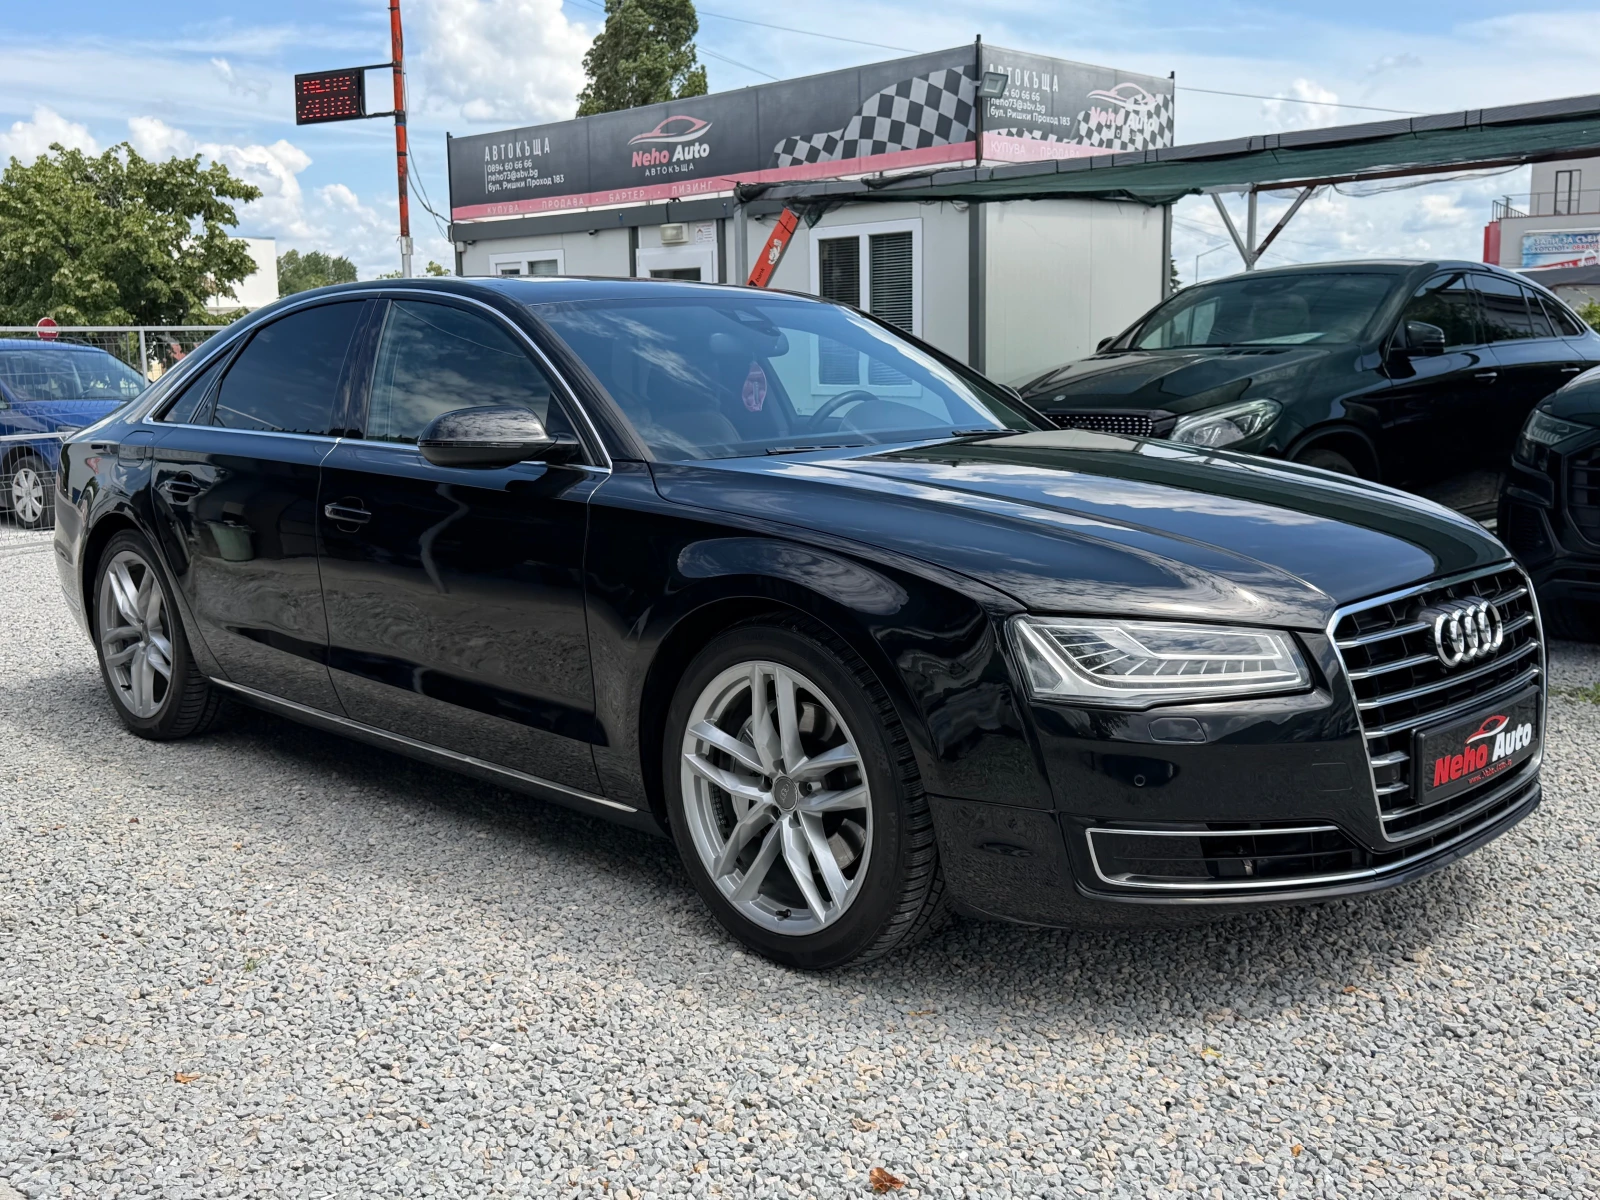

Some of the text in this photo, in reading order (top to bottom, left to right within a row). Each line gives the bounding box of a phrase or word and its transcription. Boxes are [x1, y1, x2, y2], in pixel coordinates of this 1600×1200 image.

[1011, 88, 1020, 98] 60
[1021, 90, 1030, 100] 66
[1031, 92, 1040, 102] 66
[990, 106, 1071, 126] бул. Ришки Проход 183
[485, 137, 550, 161] АВТОКЪЩА
[632, 142, 710, 168] Neho Auto
[991, 141, 1026, 155] КУПУВА
[487, 159, 532, 172] 0894 60 66 66
[645, 162, 694, 176] АВТОКЪЩА
[488, 169, 538, 181] neho73@abv.bg
[488, 174, 564, 192] бул. Ришки Проход 183
[487, 181, 713, 213] КУПУВА ПРОДАВА БАРТЕР ЛИЗИНГ
[1433, 744, 1488, 787] Neho
[1491, 722, 1533, 763] Auto
